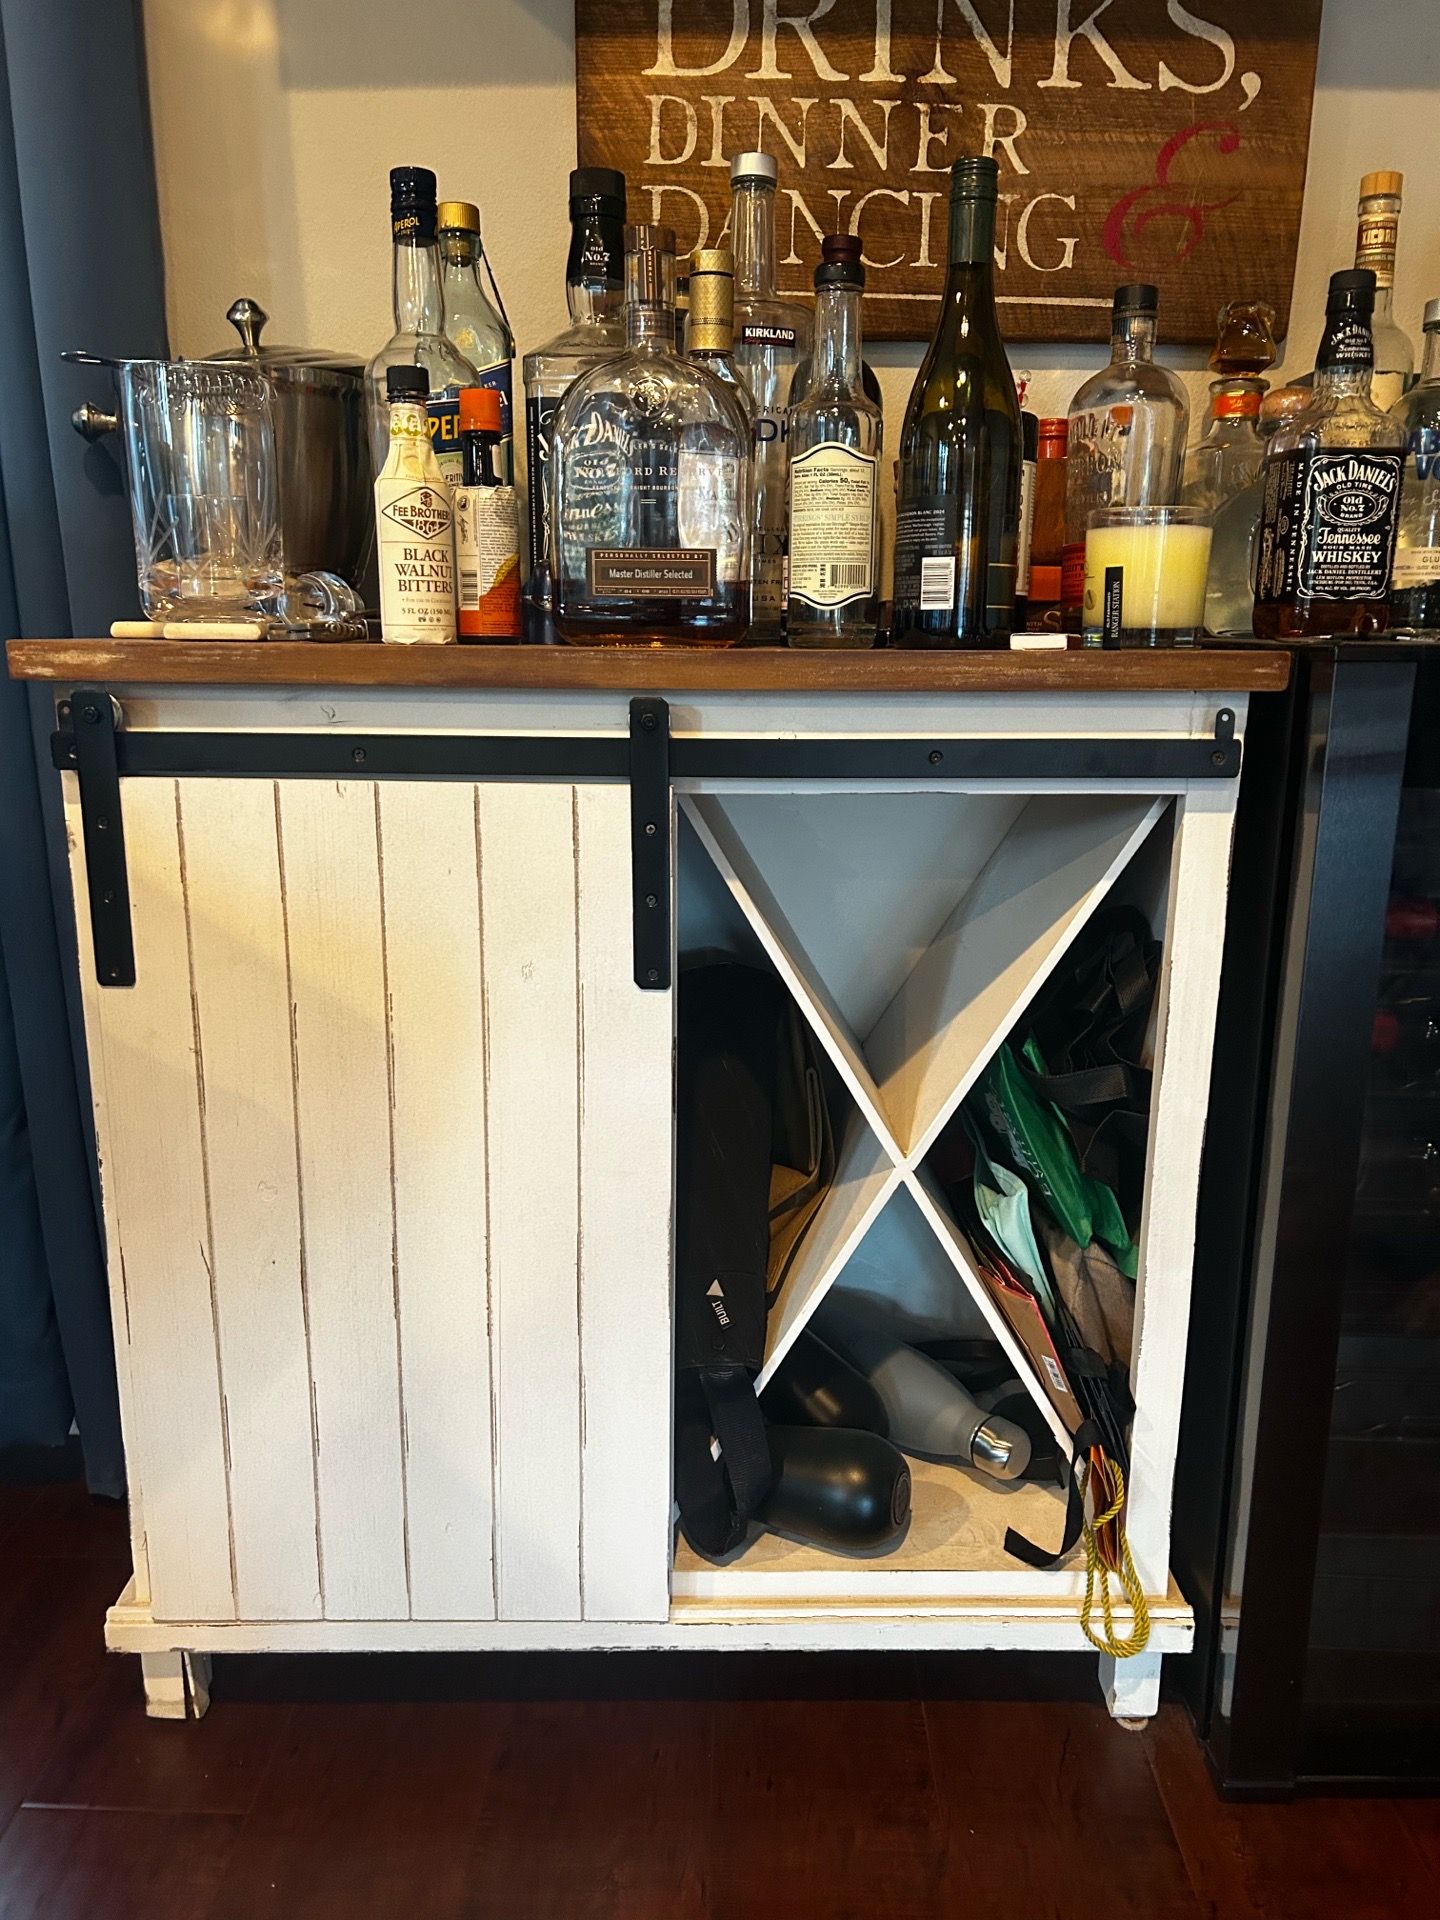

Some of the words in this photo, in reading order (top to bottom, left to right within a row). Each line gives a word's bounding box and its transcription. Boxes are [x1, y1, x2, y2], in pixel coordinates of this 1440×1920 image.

[641, 0, 1262, 111] DRINKS,
[643, 95, 1030, 175] DINNER
[584, 251, 610, 262] No.7
[745, 327, 794, 341] KIRKLAND
[1296, 462, 1304, 496] MADE
[1313, 465, 1347, 492] JACK
[1348, 460, 1397, 492] DANIEL'S
[1336, 482, 1353, 490] OLD
[1354, 482, 1372, 490] TIME
[1342, 496, 1363, 504] Old
[393, 504, 408, 516] FEE
[410, 506, 450, 521] BROTHER
[1294, 504, 1300, 516] IN
[1340, 504, 1365, 512] No.7
[1317, 528, 1380, 544] Tennessee
[404, 548, 448, 561] BLACK
[1286, 524, 1298, 592] TENNESSEE
[1311, 551, 1382, 563] WHISKEY
[395, 563, 452, 578] WALNUT
[609, 568, 633, 578] Master
[634, 568, 662, 578] Distiller
[664, 569, 693, 579] Selected
[1112, 581, 1120, 609] STATION
[1111, 610, 1119, 638] RANGER
[712, 1301, 730, 1325] BUILT
